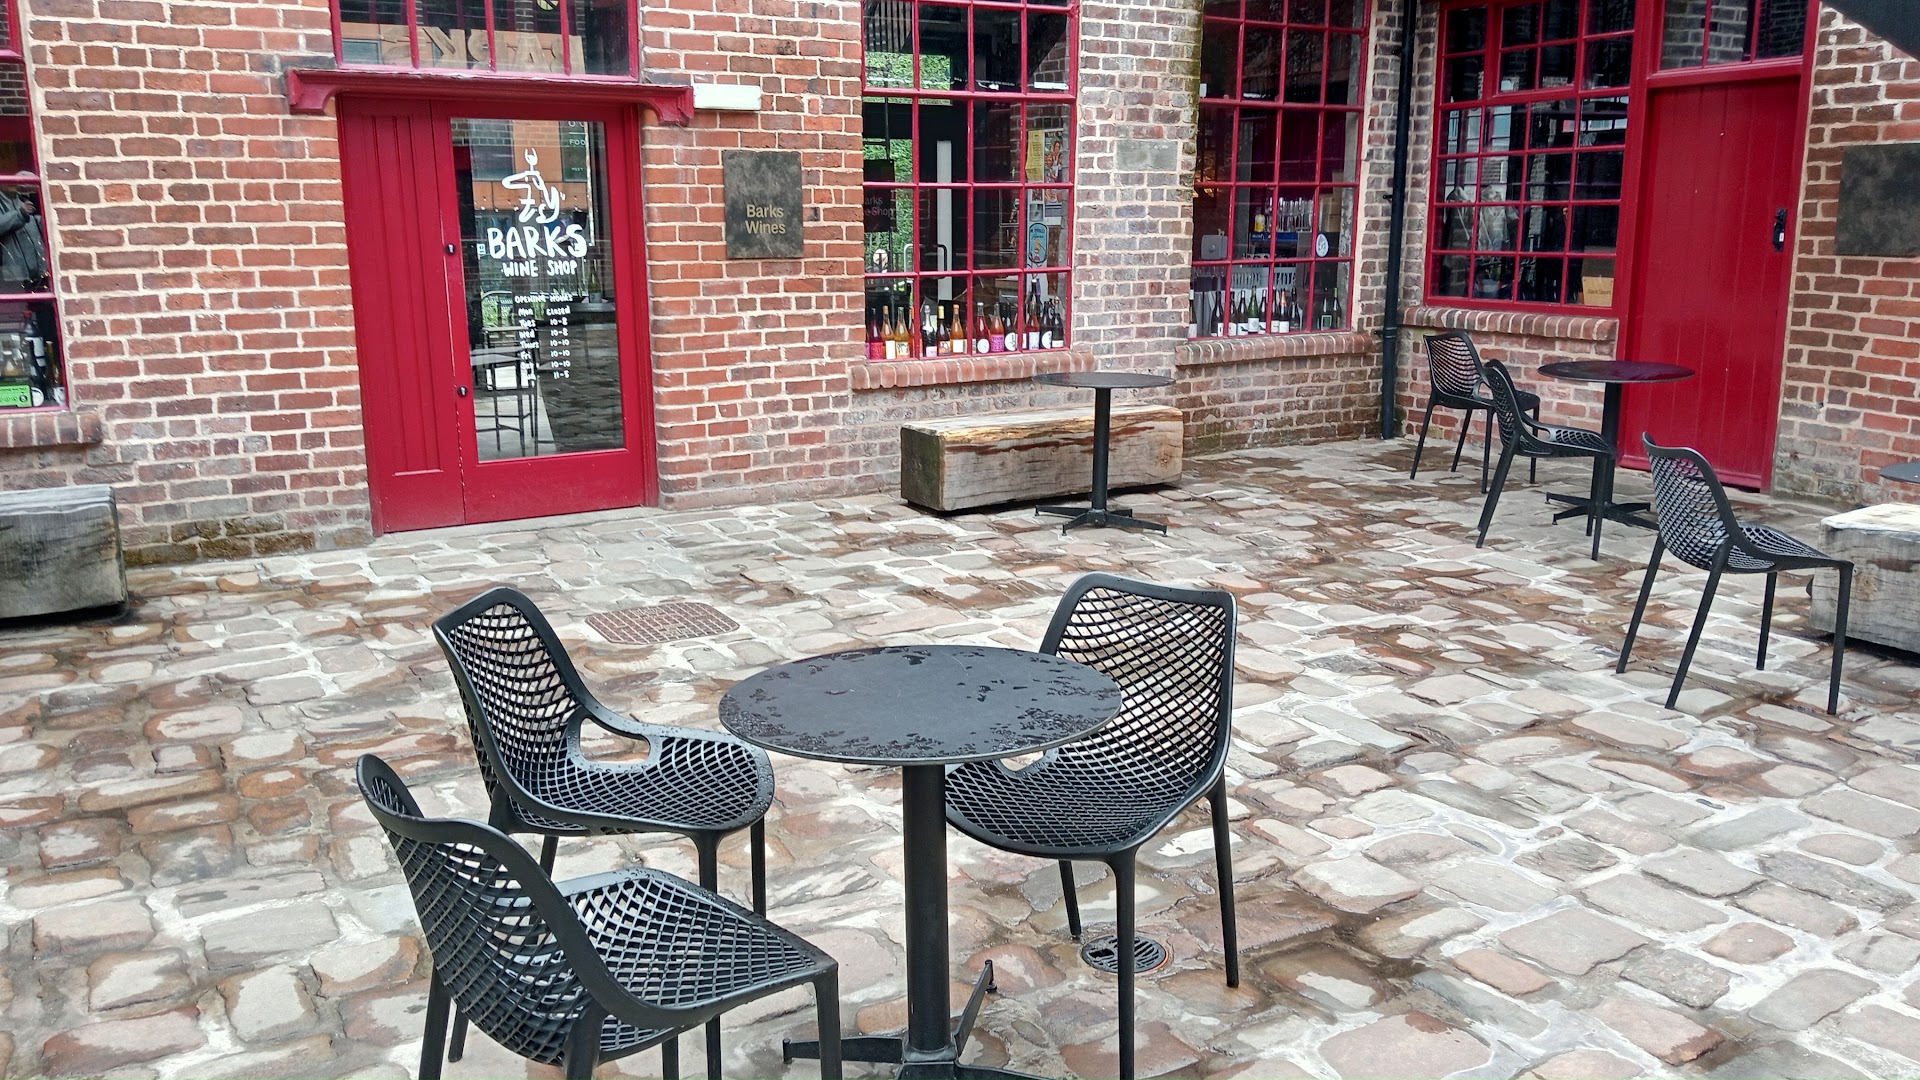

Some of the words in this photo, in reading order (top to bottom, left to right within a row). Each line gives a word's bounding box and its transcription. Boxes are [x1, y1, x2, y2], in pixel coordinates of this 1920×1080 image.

[746, 204, 784, 218] Barks
[745, 220, 786, 234] Wines
[487, 224, 588, 259] BARKS
[502, 260, 539, 277] WINE
[547, 260, 578, 276] SHOP
[514, 295, 546, 303] OPENING
[518, 308, 533, 316] Mon
[546, 305, 570, 316] Closed
[519, 319, 536, 327] Tues
[550, 317, 568, 326] 10-8
[550, 328, 568, 336] 10-8
[520, 351, 531, 360] Fri
[553, 370, 570, 379] 11-5
